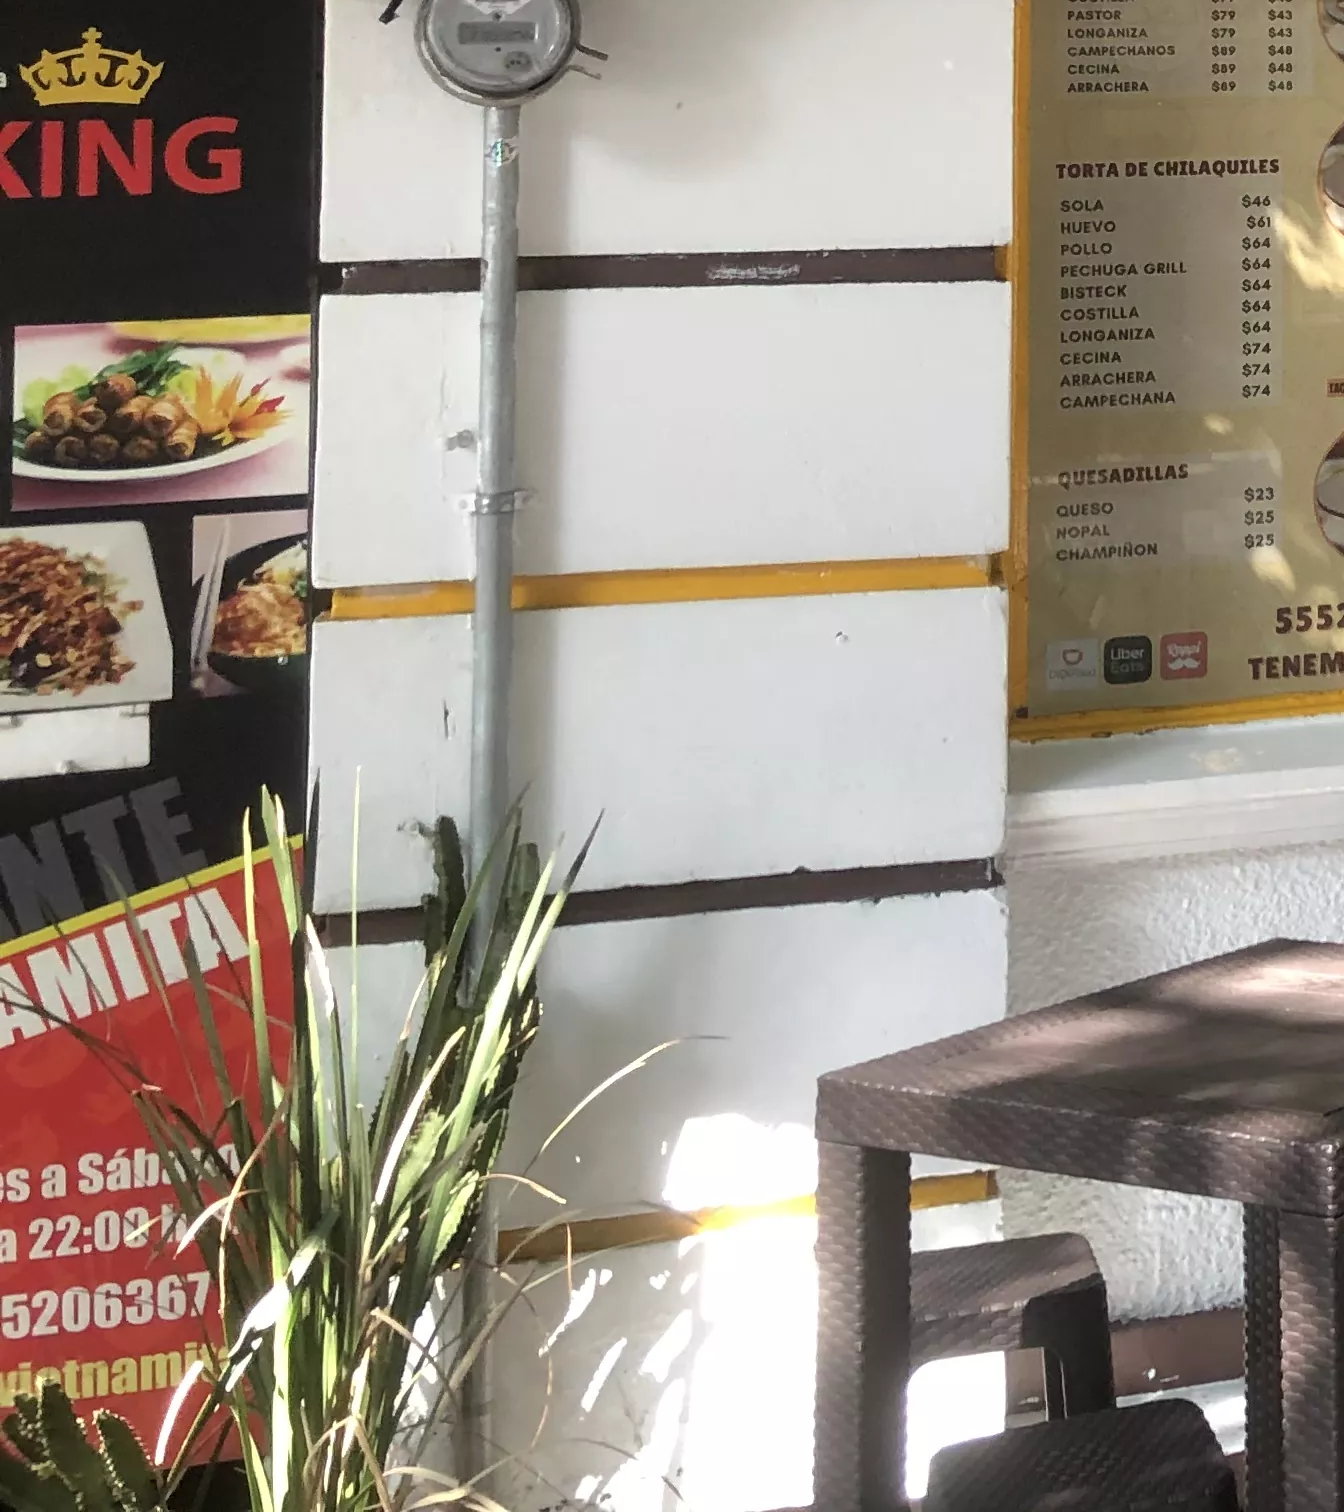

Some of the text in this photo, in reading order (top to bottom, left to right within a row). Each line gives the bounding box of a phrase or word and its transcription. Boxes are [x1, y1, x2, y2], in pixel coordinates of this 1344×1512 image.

[1055, 158, 1280, 180] TORTA DE CHILAQUILES
[1060, 194, 1271, 213] SOLA $46
[1060, 215, 1271, 235] HUEVO $61
[1060, 257, 1271, 278] PECHUGA GRILL $64
[1057, 463, 1189, 491] QUESADILLAS
[1056, 486, 1275, 518] QUESO $23
[1055, 533, 1275, 562] CHAMPIÑON $25
[0, 776, 208, 939] NTE
[40, 1163, 67, 1200] a
[28, 1207, 149, 1260] 22:00
[1, 1270, 211, 1340] 5206367
